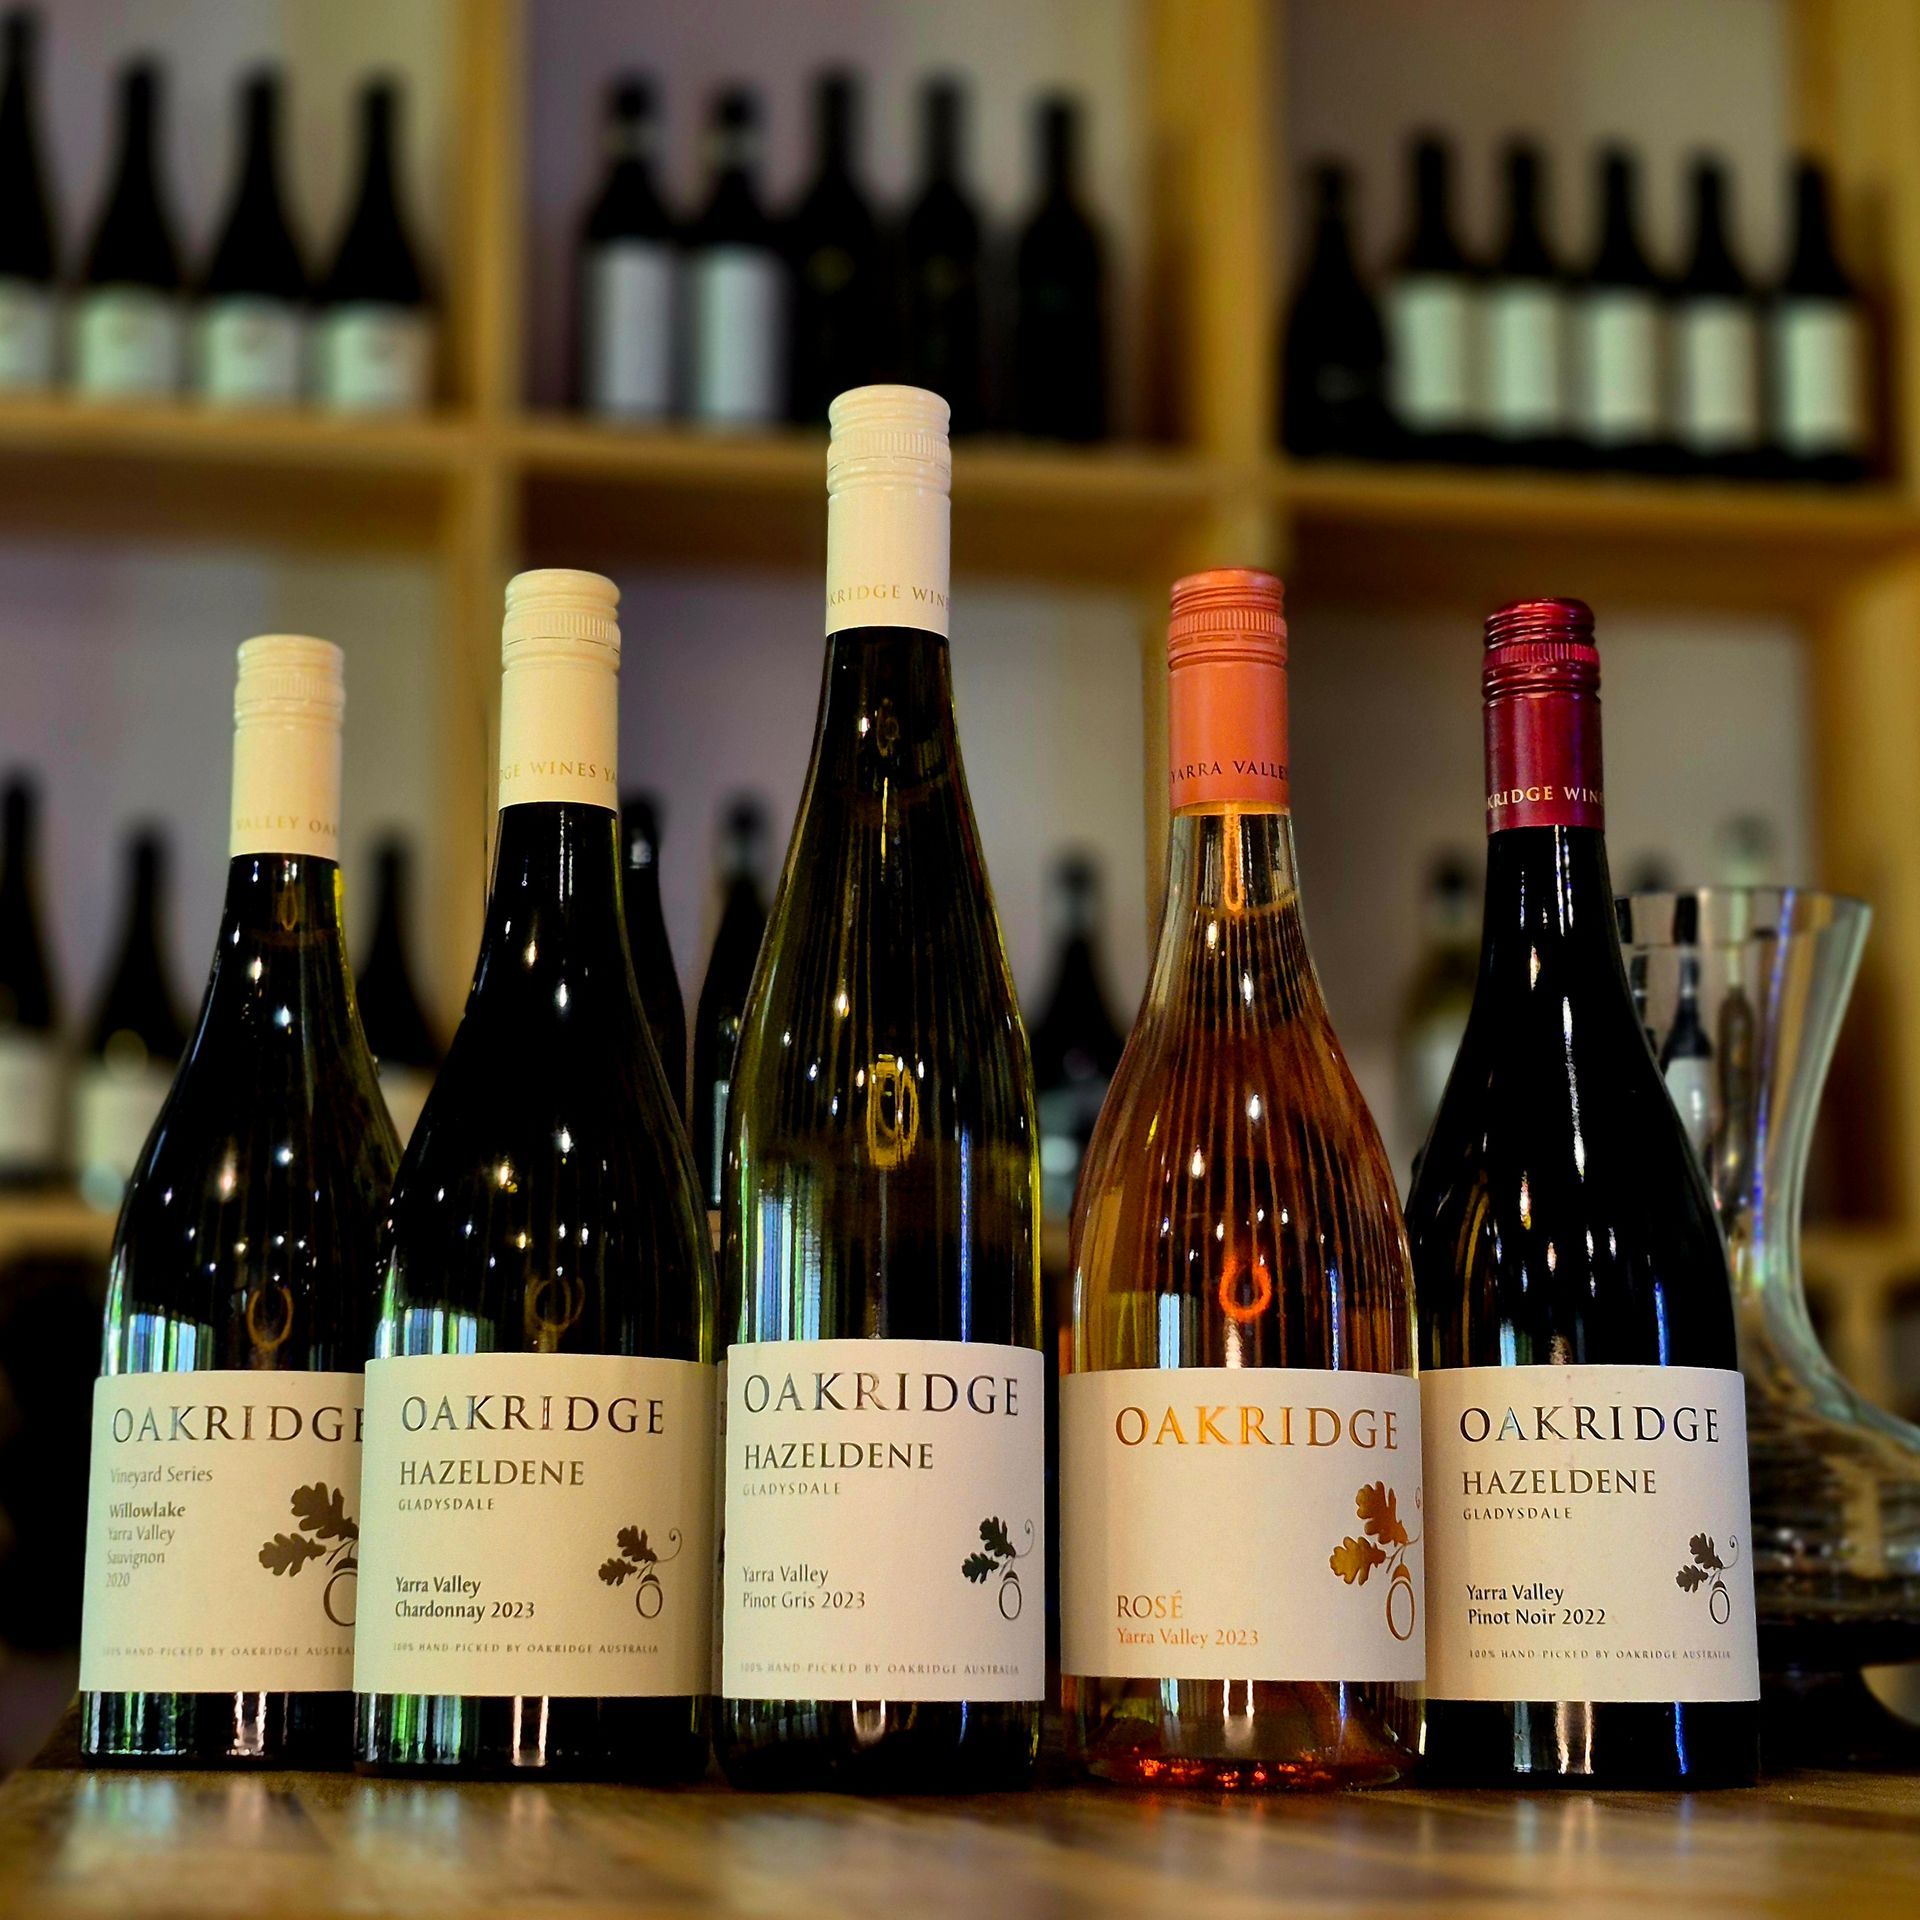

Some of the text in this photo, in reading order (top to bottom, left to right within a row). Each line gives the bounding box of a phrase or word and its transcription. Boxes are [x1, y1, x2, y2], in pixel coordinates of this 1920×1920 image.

[829, 584, 902, 608] KRIDGE
[529, 761, 597, 778] WINES
[1171, 761, 1222, 784] YARRA
[743, 1372, 1020, 1416] OAKRIDGE
[401, 1394, 666, 1435] OAKRIDGE
[1459, 1405, 1720, 1443] OAKRIDGE
[1115, 1405, 1399, 1450] OAKRIDGE
[744, 1442, 935, 1470] HAZELDENE
[110, 1465, 214, 1489] Vineyard Series
[399, 1459, 586, 1486] HAZELDENE
[1462, 1469, 1658, 1496] HAZELDENE
[742, 1481, 842, 1496] GLADYSDALE
[109, 1501, 186, 1519] Willowlake
[397, 1497, 496, 1512] GLADYSDALE
[1462, 1506, 1574, 1521] GLADYSDALE
[108, 1524, 176, 1546] Yarra Valley
[106, 1549, 166, 1570] Sauvignon
[395, 1575, 482, 1598] Yarra Valley
[742, 1564, 830, 1588] Yarra Valley
[742, 1591, 867, 1609] Pinot Gris 2023
[1116, 1590, 1184, 1619] ROSÉ
[1466, 1582, 1565, 1606] Yarra Valley
[394, 1600, 536, 1624] Chardonnay 2023
[1467, 1608, 1607, 1626] Pinot Noir 2022
[1116, 1626, 1260, 1649] Yarra Valley 2023
